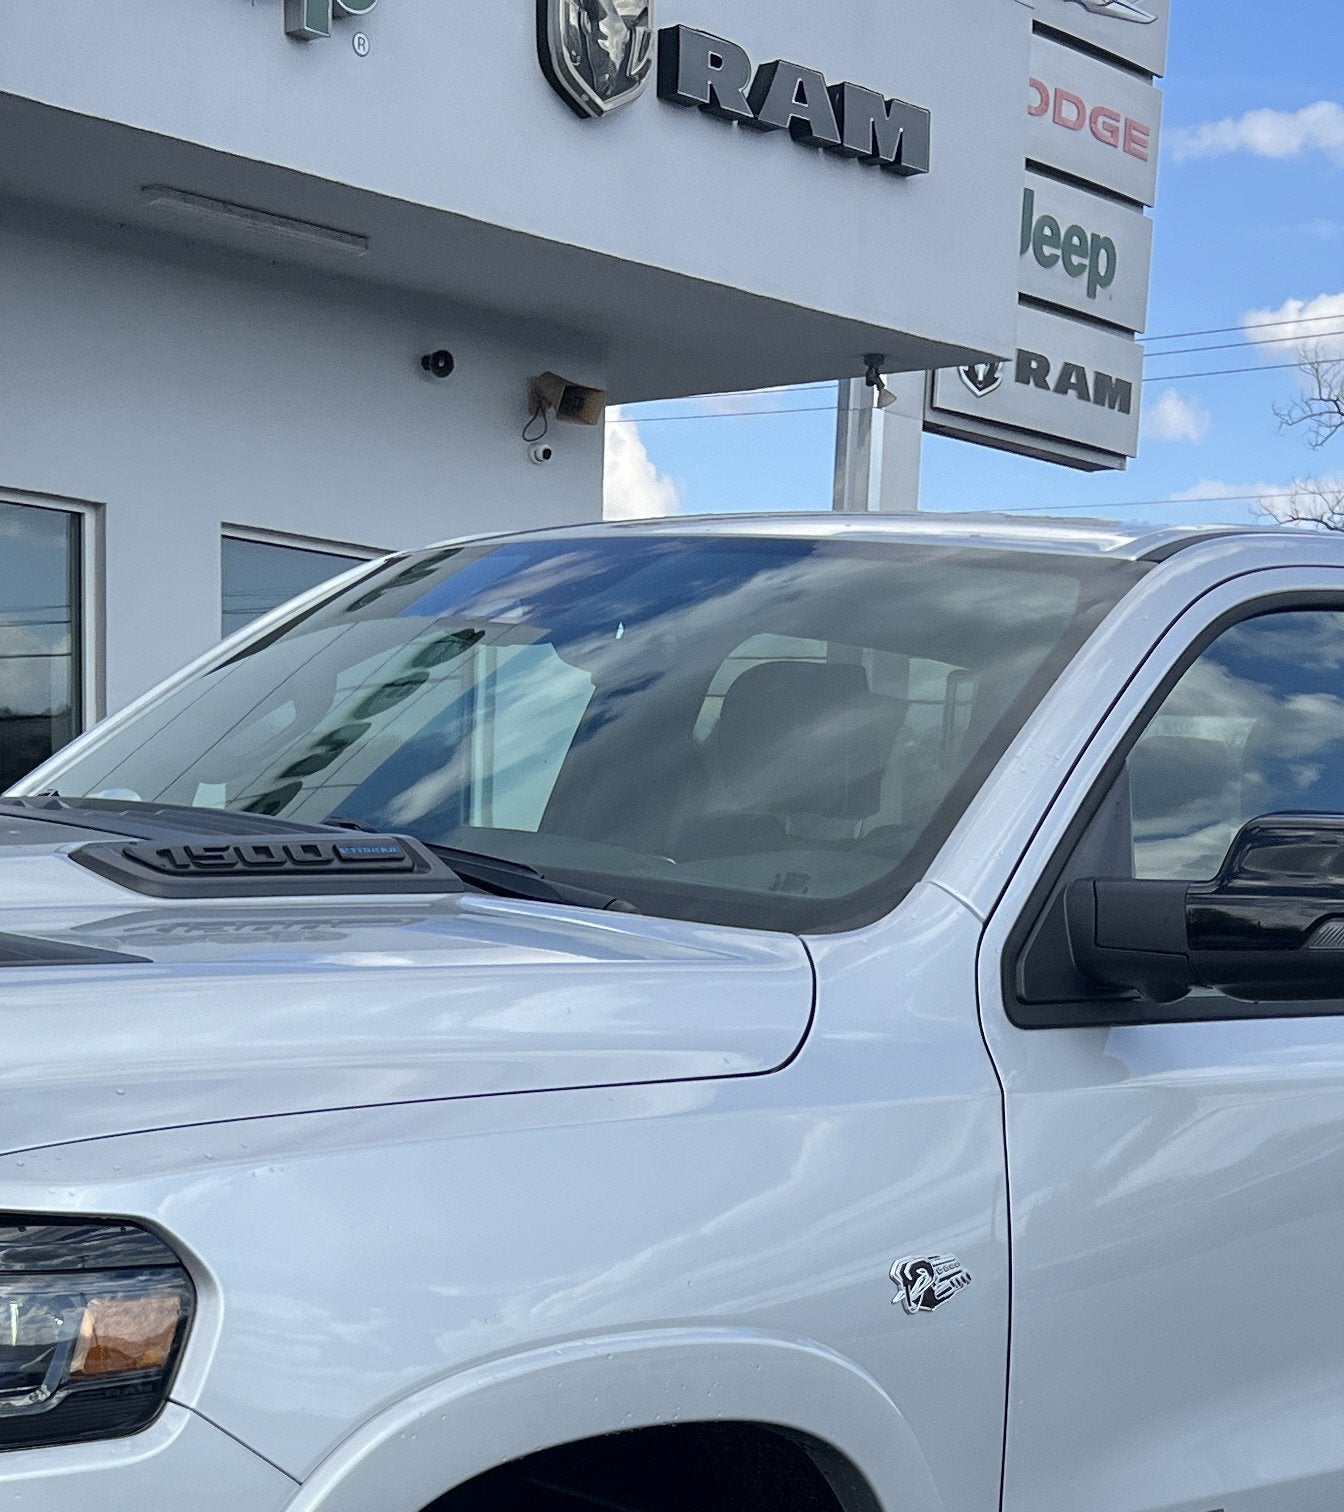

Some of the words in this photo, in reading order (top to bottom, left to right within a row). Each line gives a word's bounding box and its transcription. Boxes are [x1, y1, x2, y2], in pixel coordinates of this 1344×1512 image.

[656, 24, 931, 176] RAM
[1014, 347, 1132, 415] RAM
[155, 843, 336, 869] 1500
